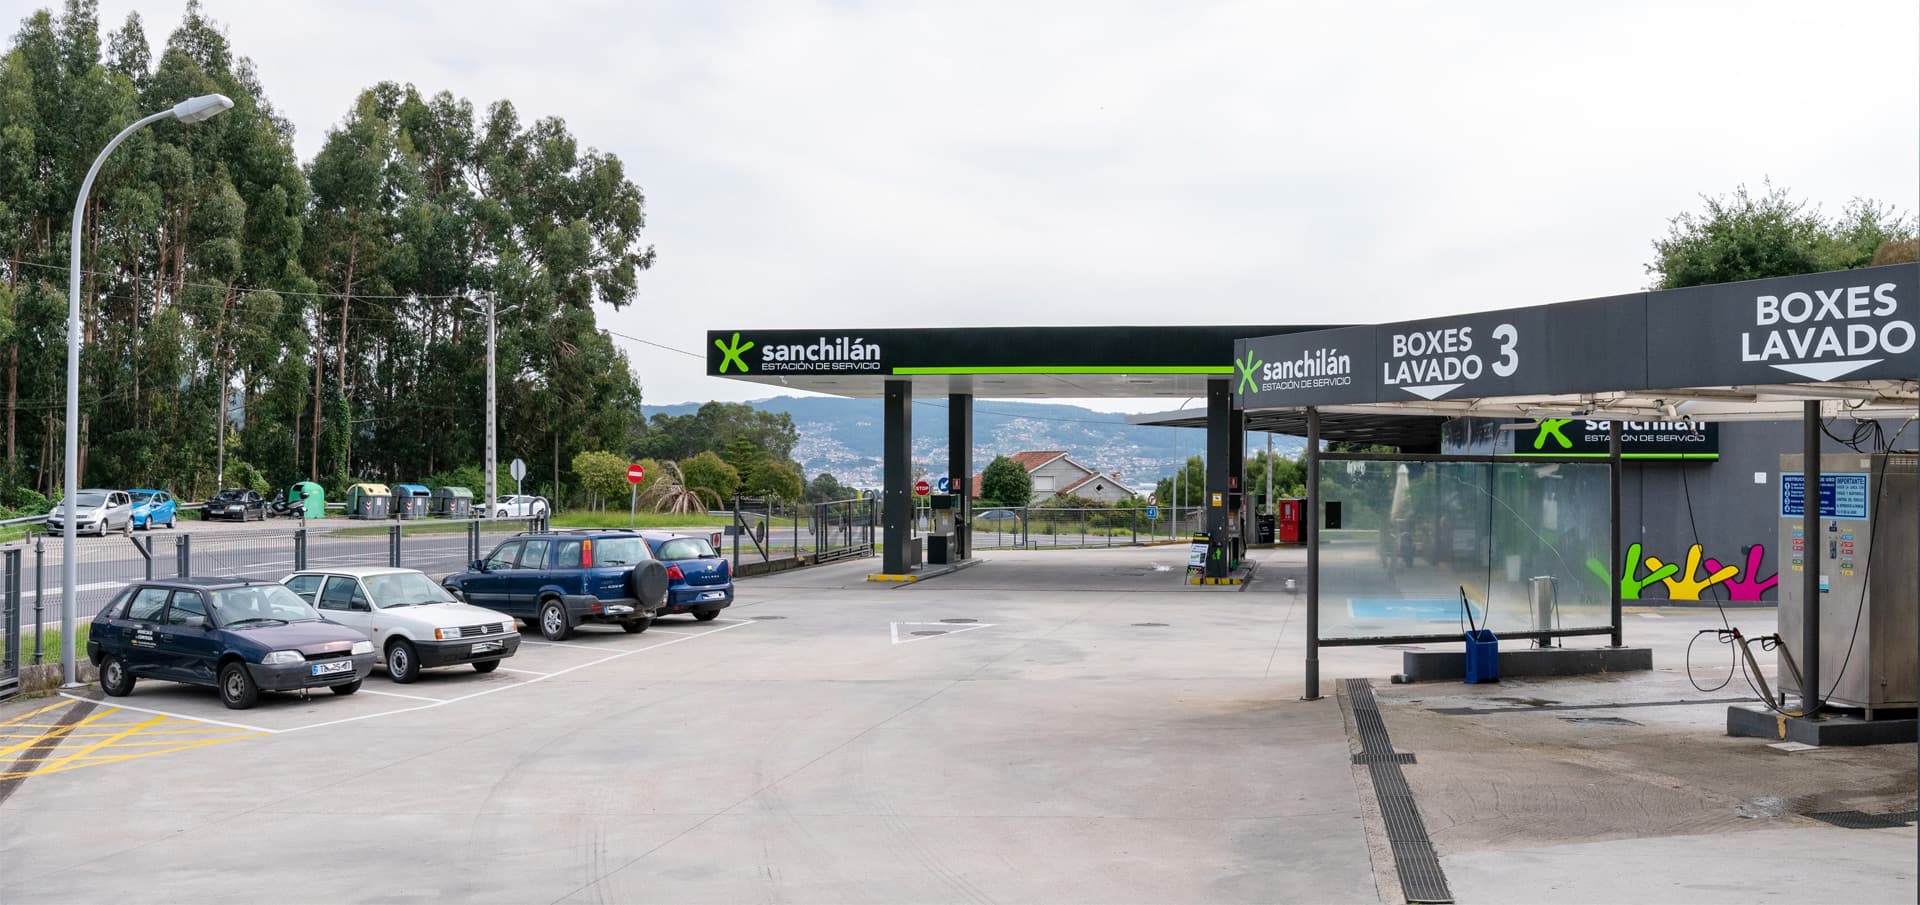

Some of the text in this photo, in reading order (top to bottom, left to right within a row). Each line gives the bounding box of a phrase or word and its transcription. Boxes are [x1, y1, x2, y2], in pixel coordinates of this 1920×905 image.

[1757, 283, 1897, 326] BOXES
[762, 337, 880, 361] sanchilán
[1393, 326, 1472, 358] BOXES
[1491, 323, 1519, 377] 3
[1742, 320, 1916, 362] LAVADO
[762, 361, 881, 371] ESTACIÓN DE SERVICIO
[1263, 347, 1351, 381] sanchilán
[1384, 354, 1483, 385] LAVADO
[1262, 376, 1351, 392] ESTACIÓN DE SERVICIO
[1584, 434, 1639, 442] ESTAÓN
[1639, 434, 1653, 442] DE
